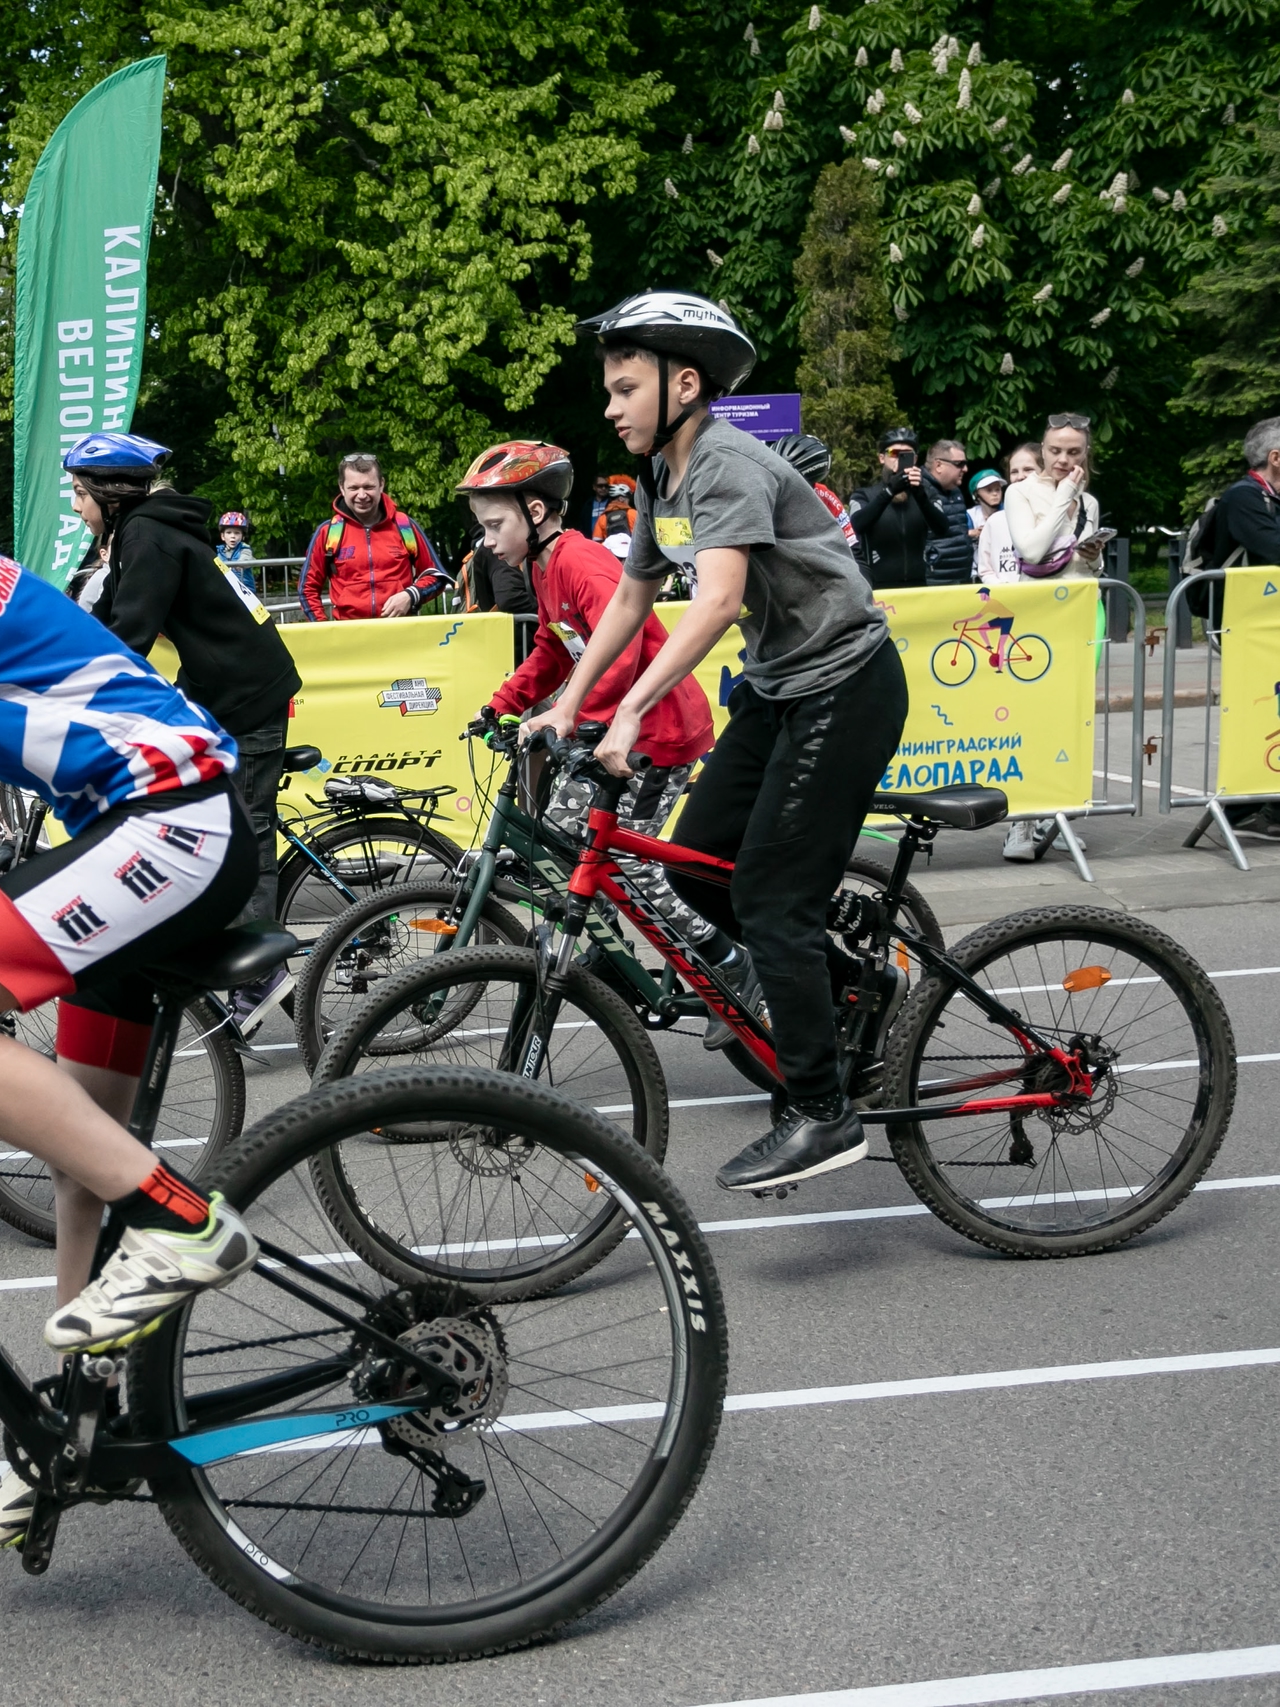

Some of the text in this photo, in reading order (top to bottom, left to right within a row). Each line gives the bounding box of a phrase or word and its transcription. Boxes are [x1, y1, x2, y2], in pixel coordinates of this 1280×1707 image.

[102, 225, 141, 429] КАЛИНИН
[711, 403, 770, 412] ИНФОРМАЦИОННЫЙ
[385, 690, 425, 700] ФЕСТИВАЛЬНАЯ
[408, 701, 435, 710] ДИРЕКЦИЯ
[332, 755, 442, 774] СПОРТ
[338, 749, 442, 761] ПЛАНЕТА
[879, 755, 1024, 790] ЕЛОПАРАД
[113, 850, 143, 879] clever
[121, 857, 170, 900] fit
[51, 895, 83, 922] clever
[533, 860, 636, 958] GINT
[58, 902, 107, 943] fit
[641, 1201, 707, 1333] MAXXIS
[335, 1409, 370, 1427] PRO
[243, 1542, 270, 1567] pro
